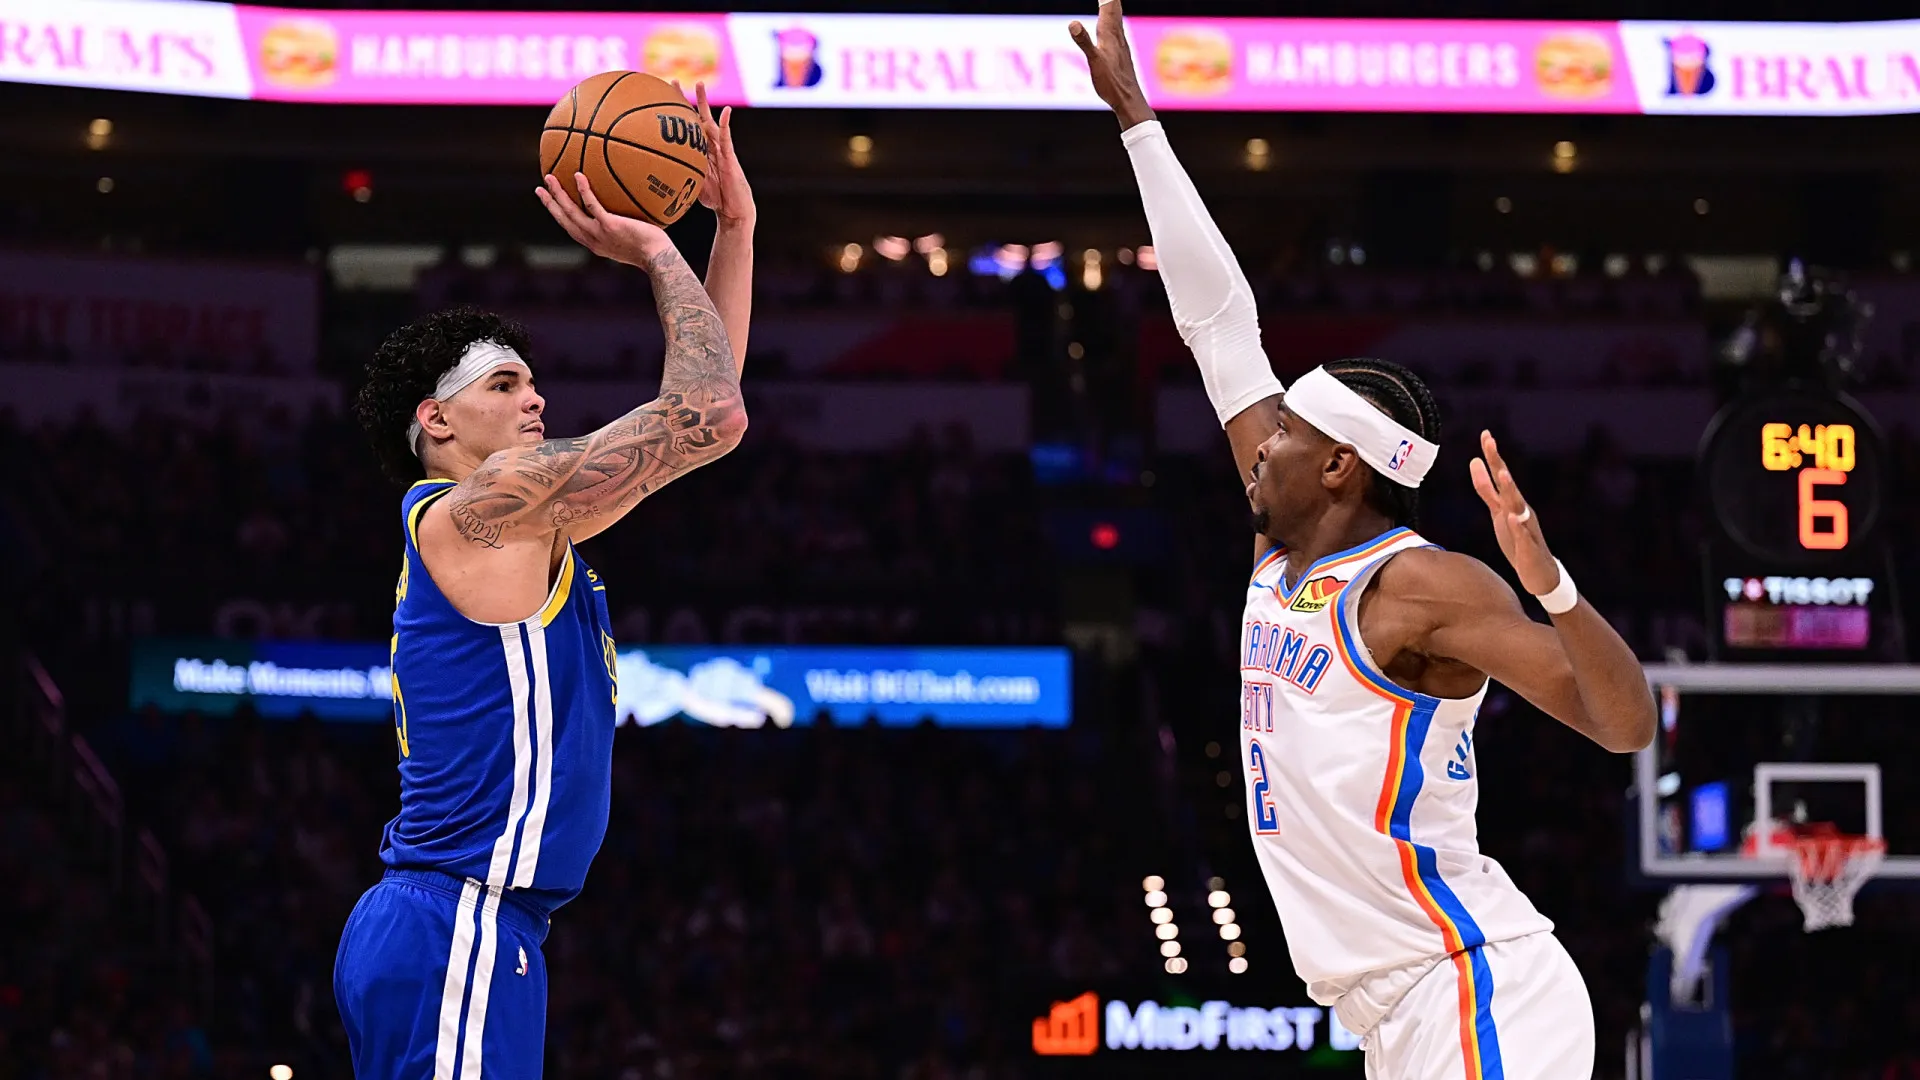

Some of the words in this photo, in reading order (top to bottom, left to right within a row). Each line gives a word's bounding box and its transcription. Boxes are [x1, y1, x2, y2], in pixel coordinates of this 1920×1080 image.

[352, 33, 629, 79] HAMBURGERS
[1246, 40, 1520, 88] HAMBURGERS
[1762, 423, 1856, 472] 6:40
[1798, 467, 1848, 550] 6
[1763, 576, 1874, 606] TISSOT
[250, 660, 368, 699] Moments
[805, 668, 869, 703] Visit
[1250, 737, 1281, 836] 2
